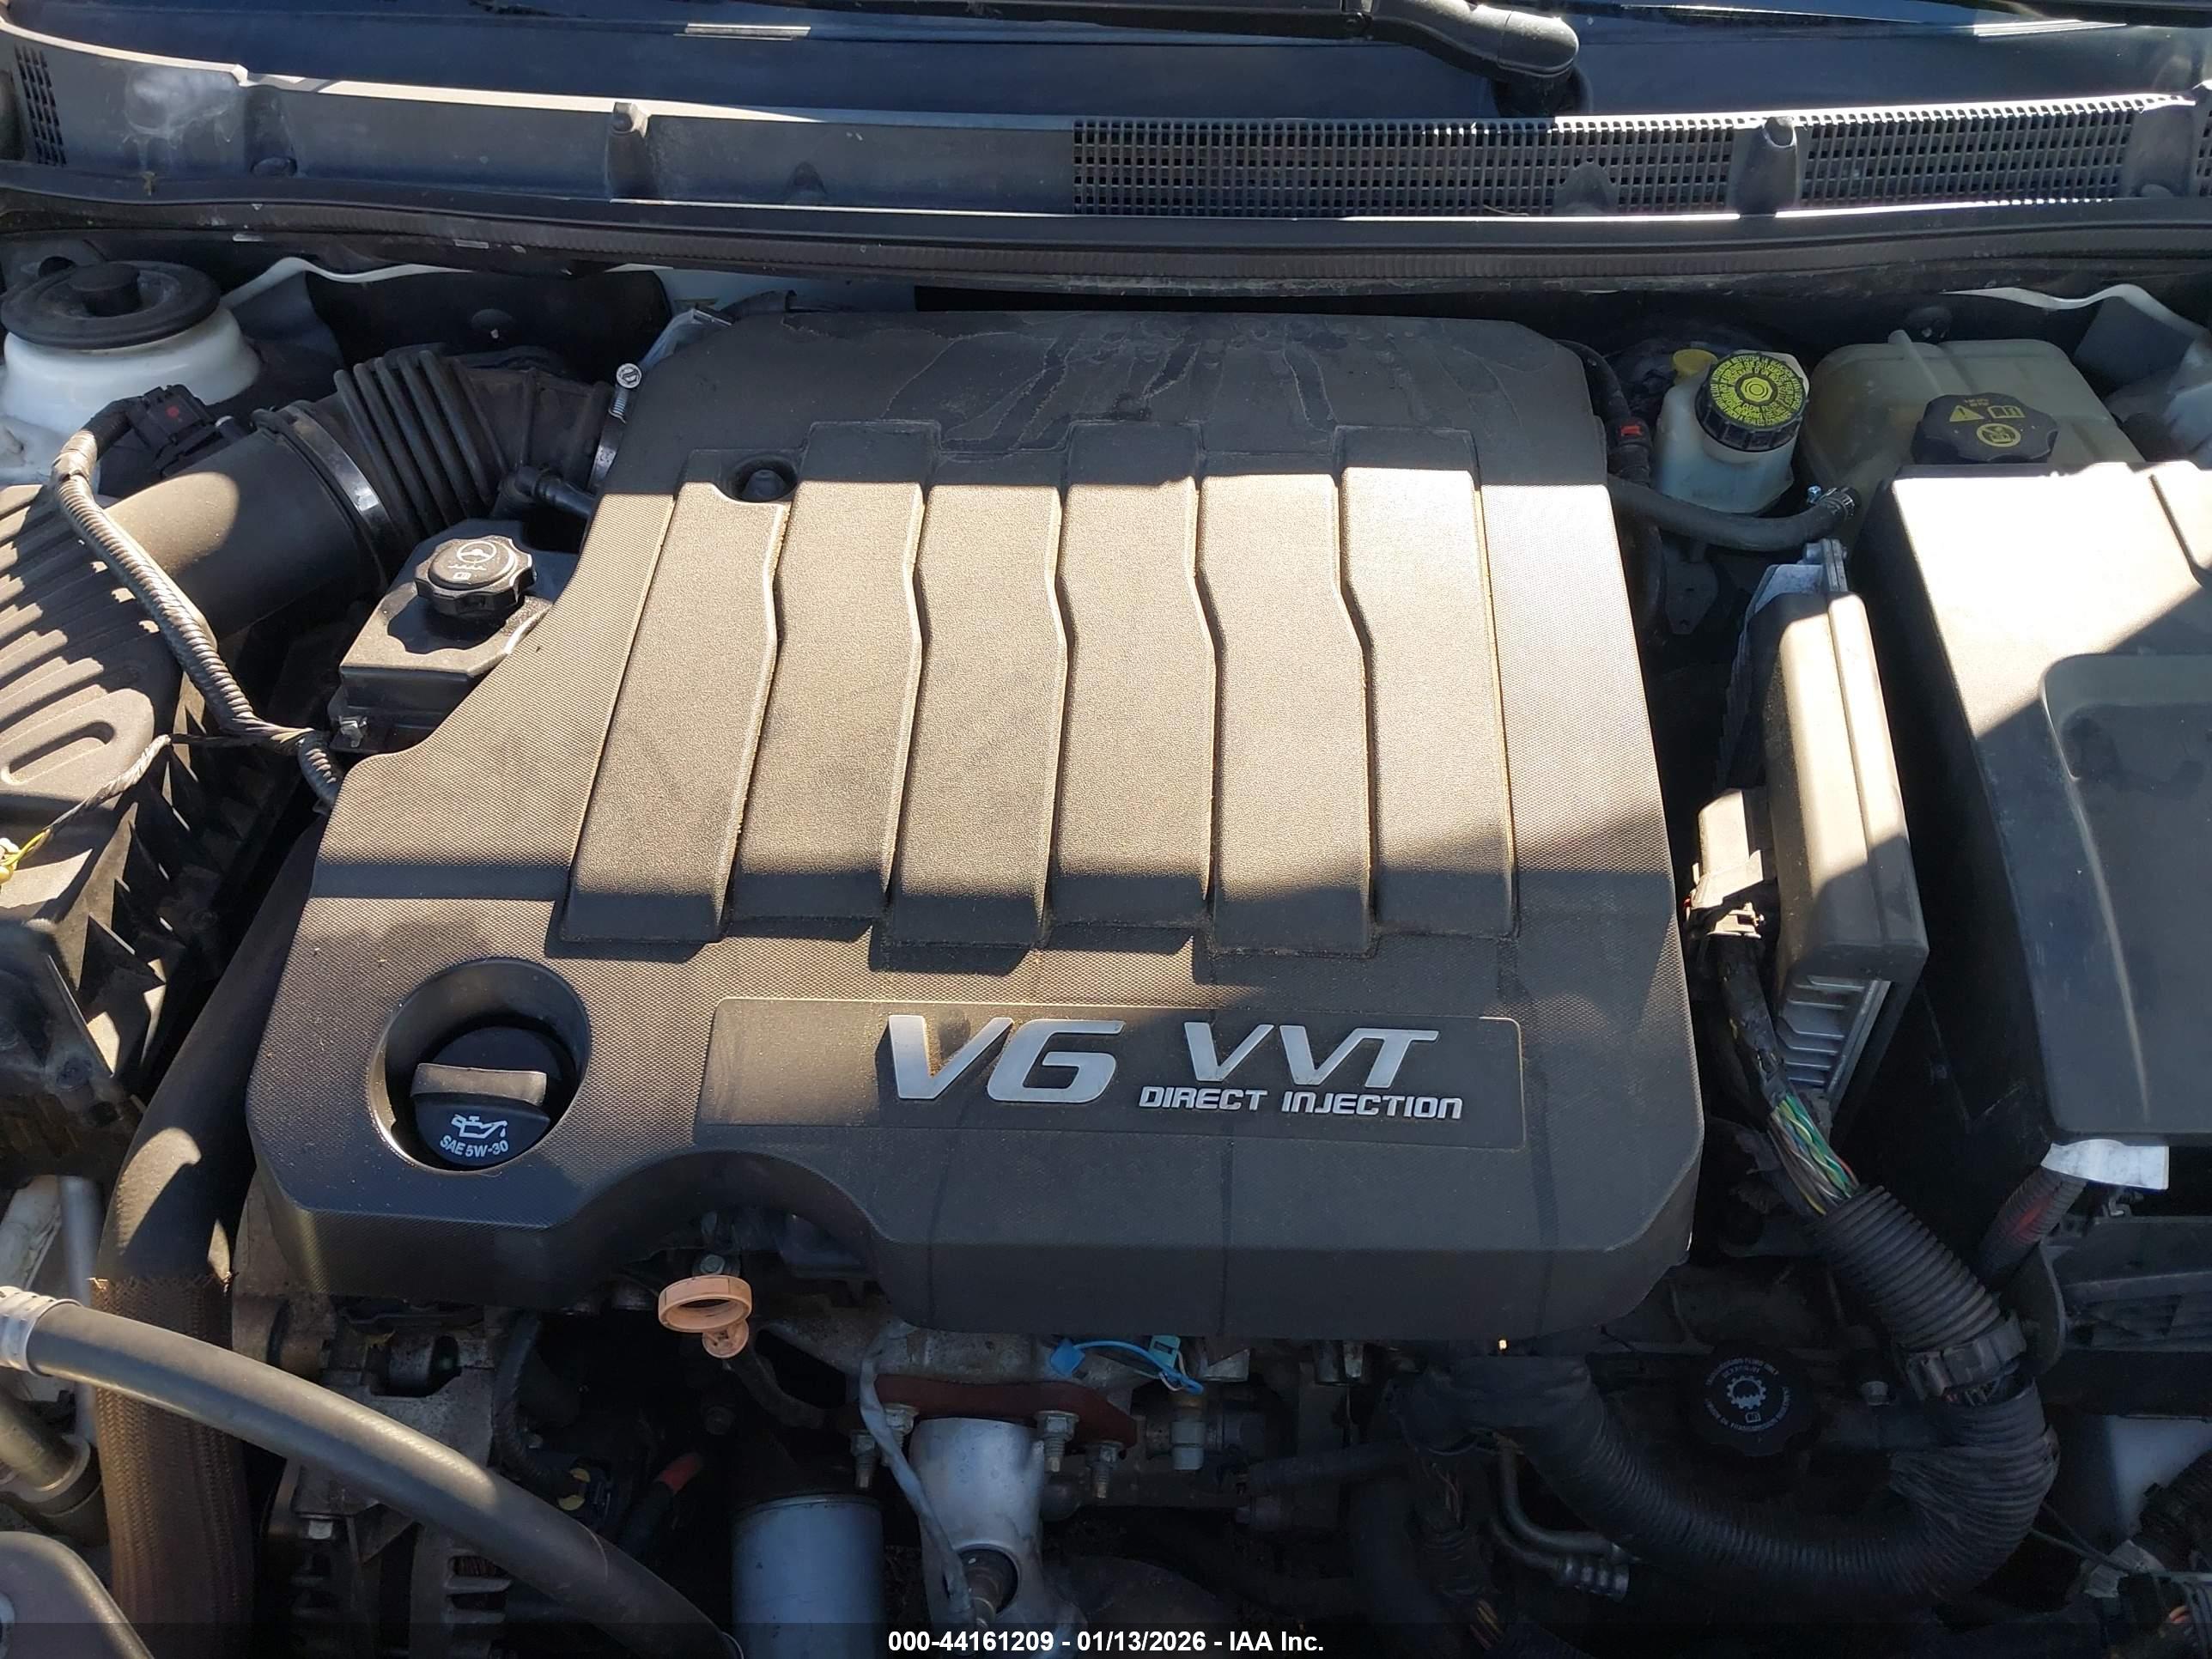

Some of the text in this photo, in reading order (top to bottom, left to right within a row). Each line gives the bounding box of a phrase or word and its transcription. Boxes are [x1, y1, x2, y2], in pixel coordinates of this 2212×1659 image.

[888, 1014, 1440, 1103] V6 VVT
[1139, 1085, 1463, 1120] DIRECT INJECTION
[440, 1134, 509, 1158] SAE 5W-30
